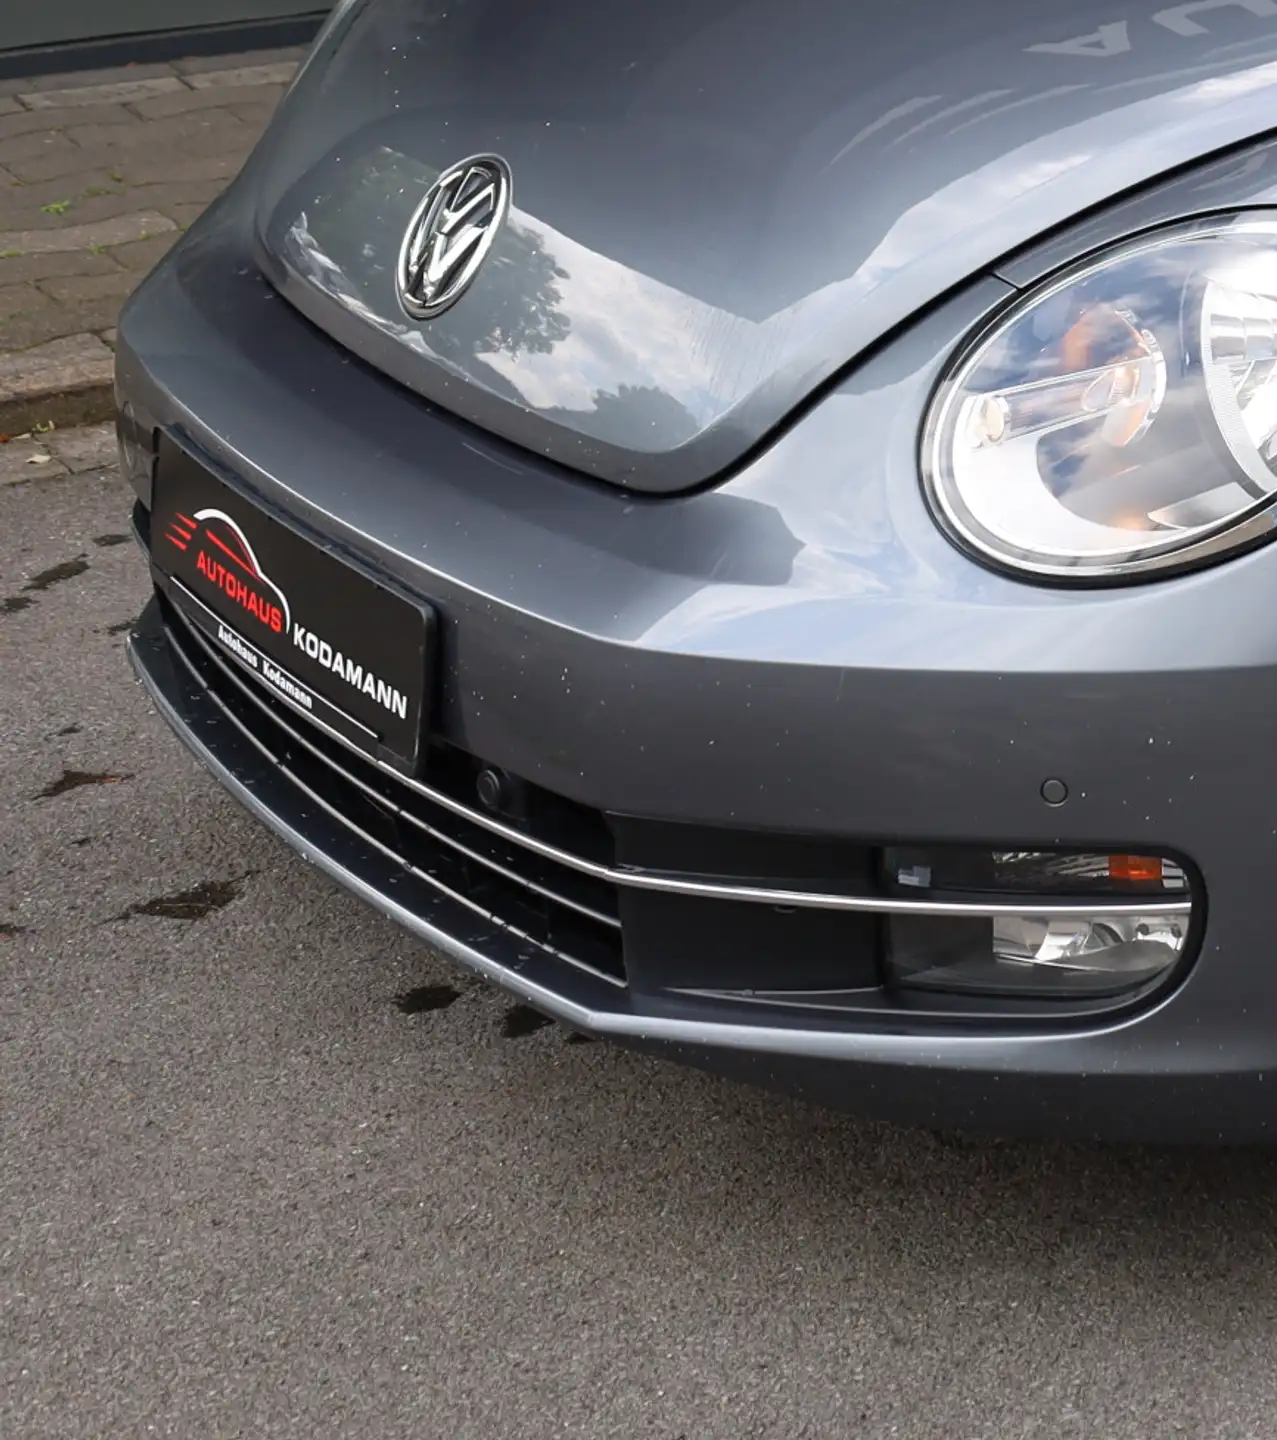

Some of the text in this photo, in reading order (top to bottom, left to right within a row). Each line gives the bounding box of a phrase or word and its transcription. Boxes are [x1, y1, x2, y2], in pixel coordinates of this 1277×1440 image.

[196, 550, 283, 634] AUTOHAUS
[218, 624, 314, 711] Autohaus Kodamann
[293, 623, 409, 720] KODAMANN
